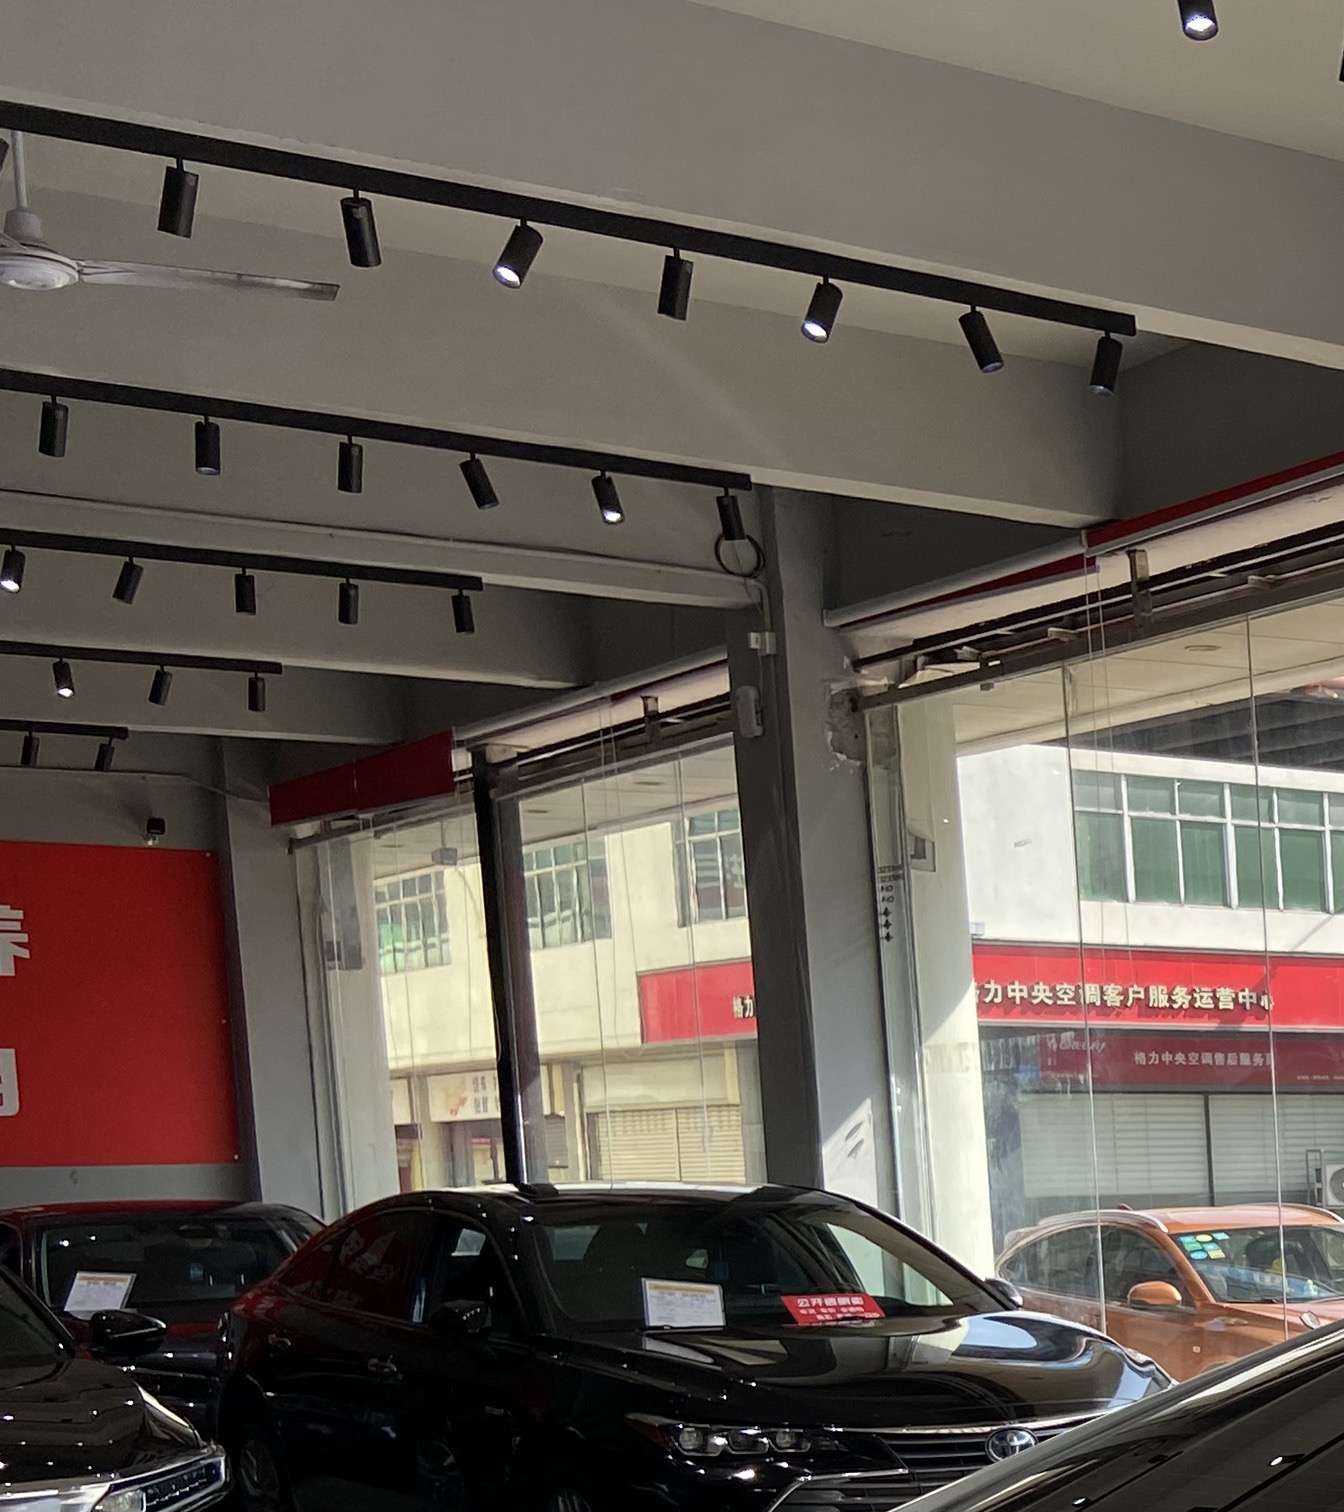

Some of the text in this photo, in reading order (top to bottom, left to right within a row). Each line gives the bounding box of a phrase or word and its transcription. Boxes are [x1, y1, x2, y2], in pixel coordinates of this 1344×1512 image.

[974, 979, 1275, 1011] 力中央空调客户服务运营中心
